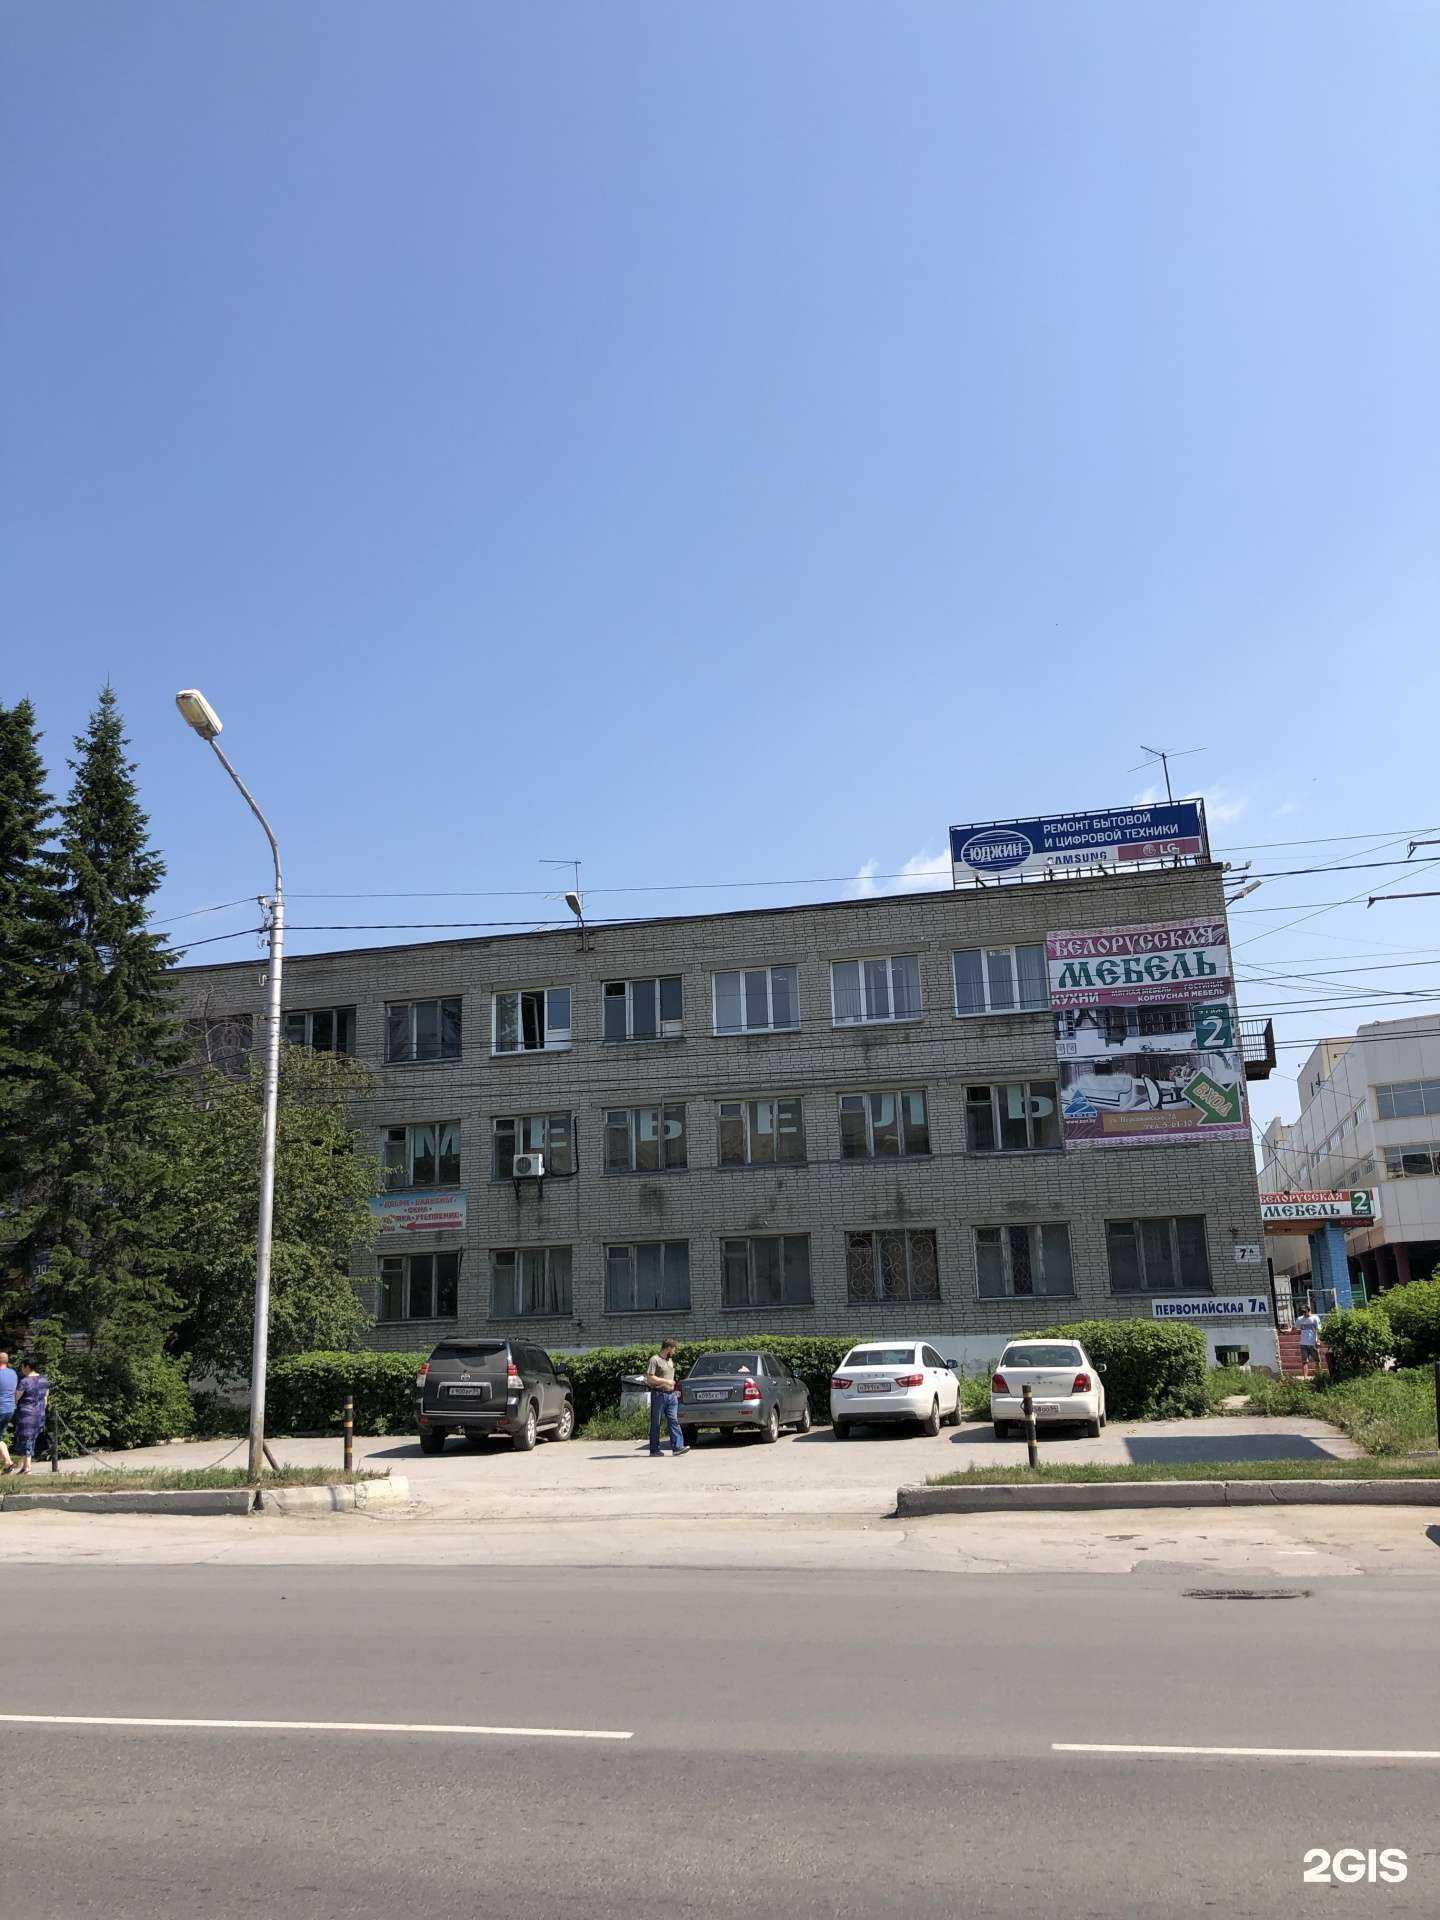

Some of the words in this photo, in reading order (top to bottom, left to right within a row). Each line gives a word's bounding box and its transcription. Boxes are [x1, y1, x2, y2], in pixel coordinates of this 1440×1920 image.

[1043, 819, 1089, 834] РЕМОНТ
[1093, 812, 1151, 829] БЫТОВОЙ
[1044, 837, 1052, 848] И
[1056, 829, 1122, 849] ЦИФРОВОЙ
[1125, 823, 1179, 840] ТЕХНИКИ
[969, 842, 1023, 862] ЮДЖИН
[1054, 927, 1216, 958] БЕЛОРУССКАЯ
[1058, 951, 1217, 989] МЕБЕЛЬ
[1051, 992, 1099, 1006] КУХНИ
[1137, 991, 1190, 1003] КОРПУСНАЯ
[1191, 987, 1225, 998] МЕБЕЛЬ
[1202, 1015, 1226, 1047] 2
[1194, 1081, 1234, 1118] ВХОД
[1260, 1192, 1344, 1204] БЕЛОРУССКАЯ
[1353, 1191, 1368, 1211] 2
[1263, 1203, 1340, 1218] МЕБЕЛЬ
[1155, 1301, 1244, 1316] ПЕРВОМАЙСКАЯ
[1248, 1299, 1267, 1313] 7А
